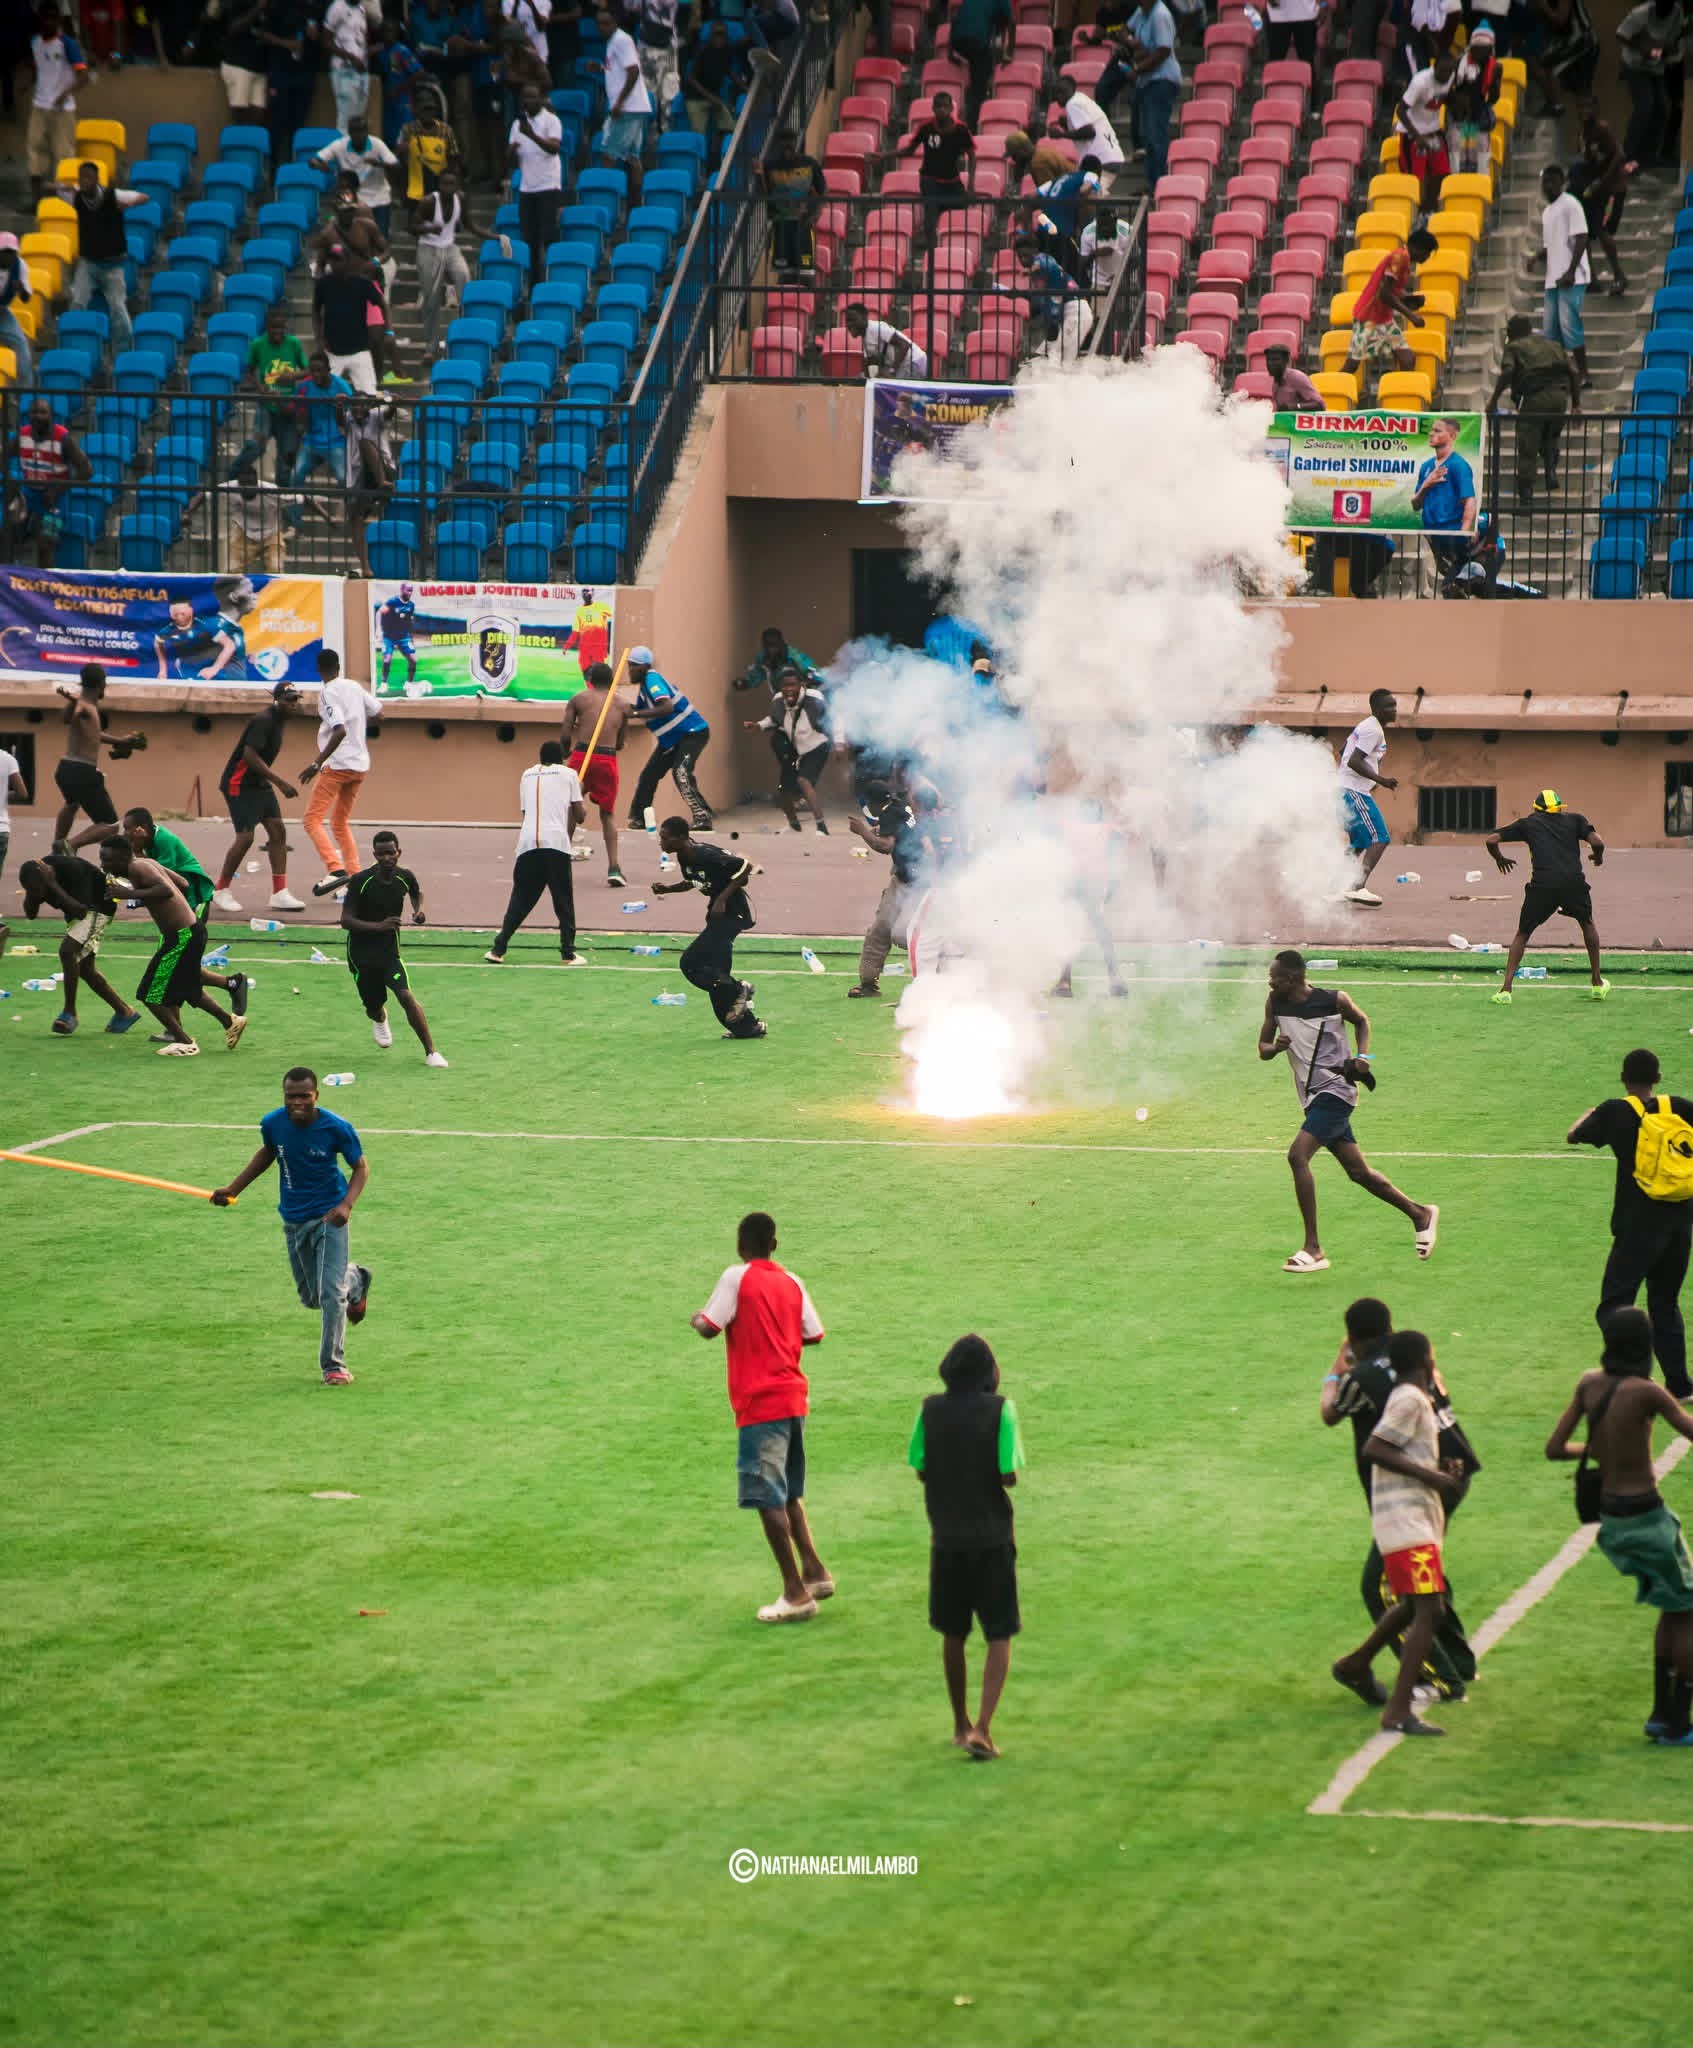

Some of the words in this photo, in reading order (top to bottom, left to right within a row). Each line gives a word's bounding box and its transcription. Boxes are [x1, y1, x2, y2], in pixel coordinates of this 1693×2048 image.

[1360, 438, 1408, 452] 100%
[1294, 456, 1345, 472] Gabriel
[1349, 458, 1415, 474] SHINDANI
